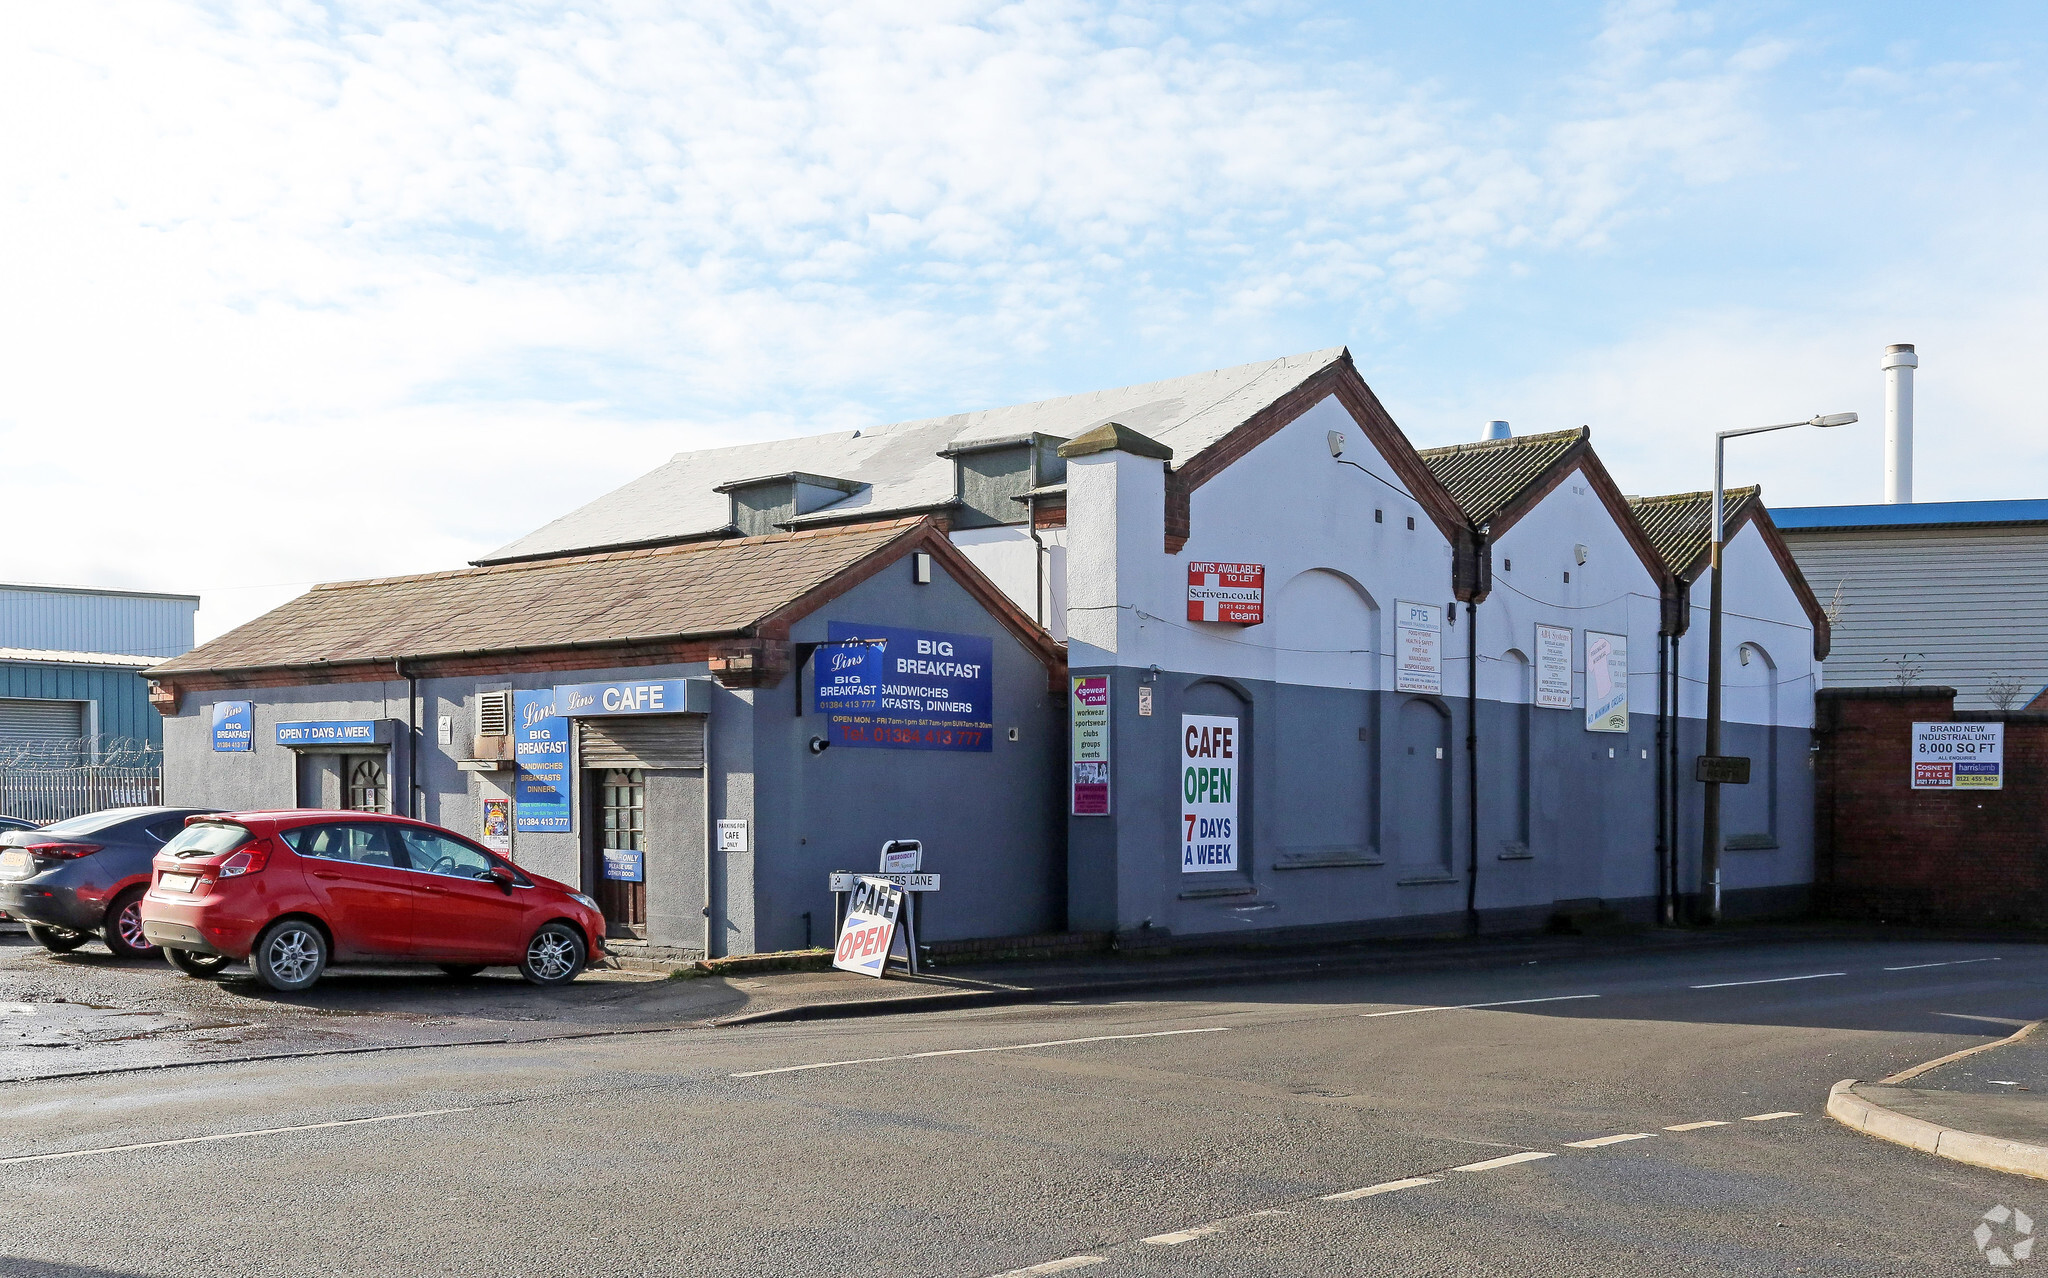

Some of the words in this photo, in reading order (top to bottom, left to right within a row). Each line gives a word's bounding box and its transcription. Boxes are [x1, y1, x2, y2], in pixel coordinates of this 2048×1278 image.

[1190, 563, 1215, 573] UNITS
[1218, 564, 1261, 574] AVAILABLE
[1190, 588, 1259, 600] Scriven.co.uk
[1230, 611, 1259, 620] team
[1410, 608, 1428, 622] PTS
[917, 640, 954, 657] BIG
[831, 653, 865, 672] Lins
[897, 658, 981, 678] BREAKFAST
[834, 675, 861, 684] BIG
[820, 685, 877, 696] BREAKFAST
[881, 684, 949, 698] SANDWICHES
[1078, 687, 1106, 696] egowear
[567, 691, 595, 711] Lins
[602, 685, 664, 711] CAFE
[1087, 694, 1106, 702] .co.uk
[820, 701, 843, 709] 01384
[862, 700, 875, 708] 777
[881, 698, 923, 712] KFASTS,
[926, 700, 972, 713] DINNERS
[223, 704, 242, 719] Lins
[522, 701, 556, 729] Lins
[832, 715, 852, 723] OPEN
[854, 716, 870, 724] MON
[1075, 720, 1106, 728] sportswear
[216, 731, 250, 739] BREAKFAST
[279, 729, 302, 739] OPEN
[304, 729, 310, 739] 7
[312, 727, 334, 738] DAYS
[336, 727, 343, 738] A
[344, 726, 370, 737] WEEK
[529, 730, 551, 740] BIG
[841, 726, 868, 741] Tel.
[874, 727, 920, 743] 01384
[925, 730, 952, 744] 413
[957, 731, 982, 744] 777
[1081, 741, 1100, 749] groups
[1185, 725, 1233, 758] CAFE
[517, 741, 567, 755] BREAKFAST
[1920, 744, 1952, 754] 8,000
[1956, 744, 1976, 753] SQ
[1980, 744, 1995, 753] FT
[520, 762, 563, 770] SANDWICHES
[520, 774, 561, 782] BREAKFASTS
[527, 785, 556, 793] DINNERS
[1184, 766, 1232, 804] OPEN
[518, 818, 540, 826] 01384
[540, 818, 554, 826] 413
[554, 818, 568, 826] 777
[1184, 814, 1196, 842] 7
[1200, 818, 1231, 839] DAYS
[622, 854, 638, 862] ONLY
[888, 852, 916, 861] EMBROIDERY
[1184, 845, 1193, 865] A
[1197, 844, 1232, 865] WEEK
[911, 876, 932, 886] LANE
[854, 882, 898, 919] CAFE
[838, 924, 891, 962] OPEN
